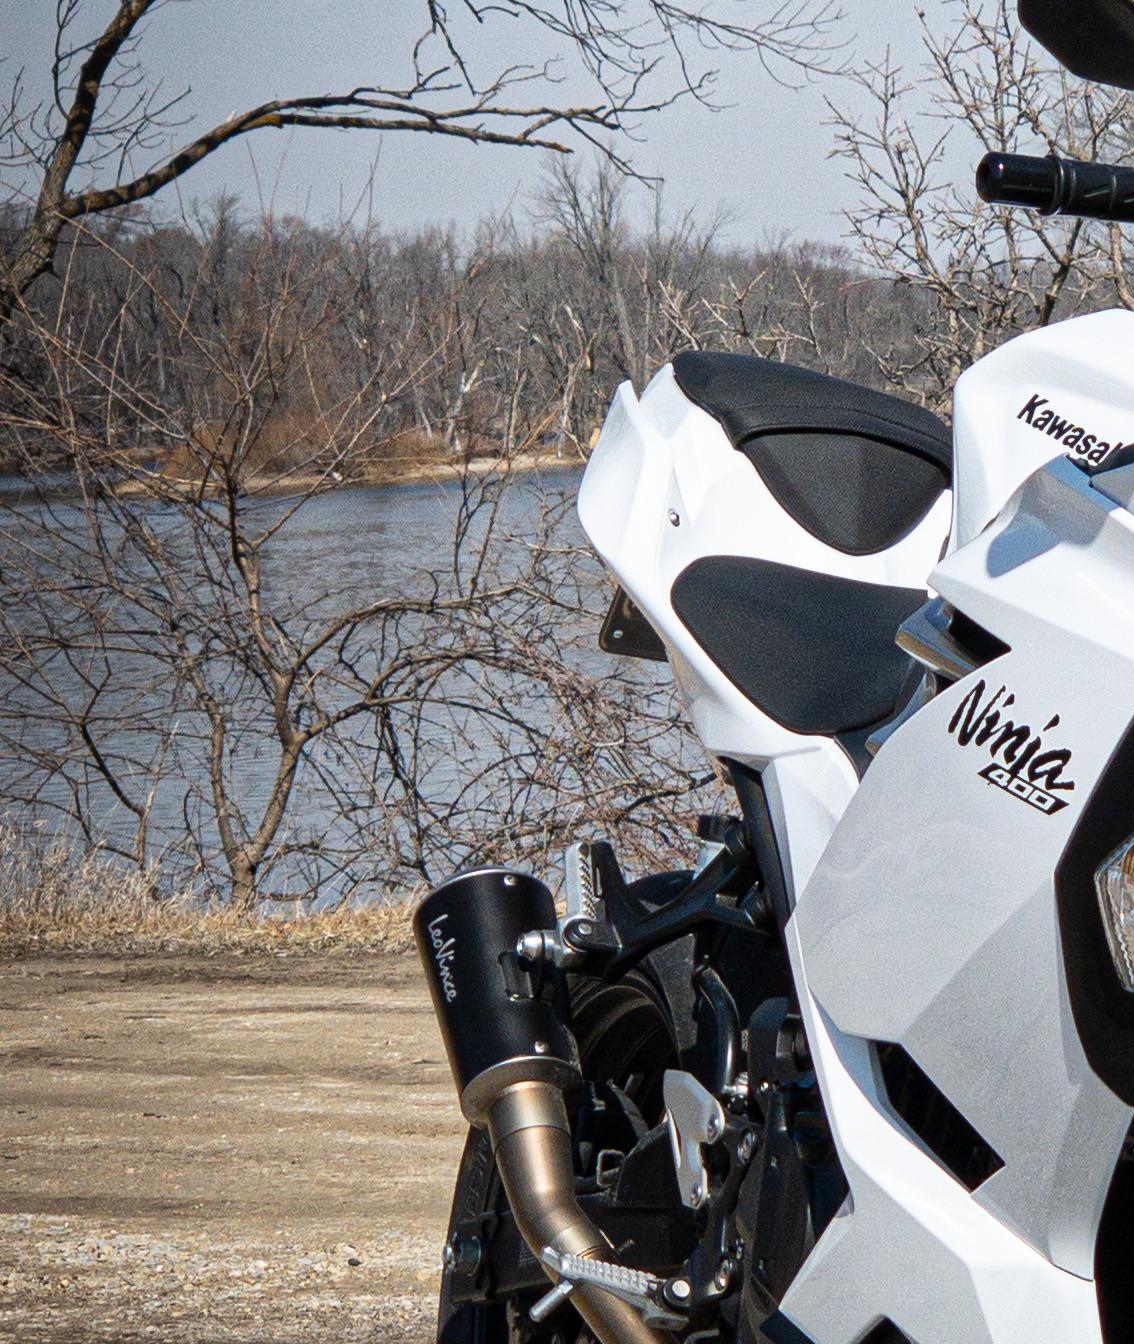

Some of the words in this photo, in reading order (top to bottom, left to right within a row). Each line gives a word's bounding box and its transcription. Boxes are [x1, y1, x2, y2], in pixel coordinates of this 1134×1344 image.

[948, 679, 1075, 790] Ninja
[987, 768, 1056, 811] 400
[427, 914, 457, 1003] LeoVince
